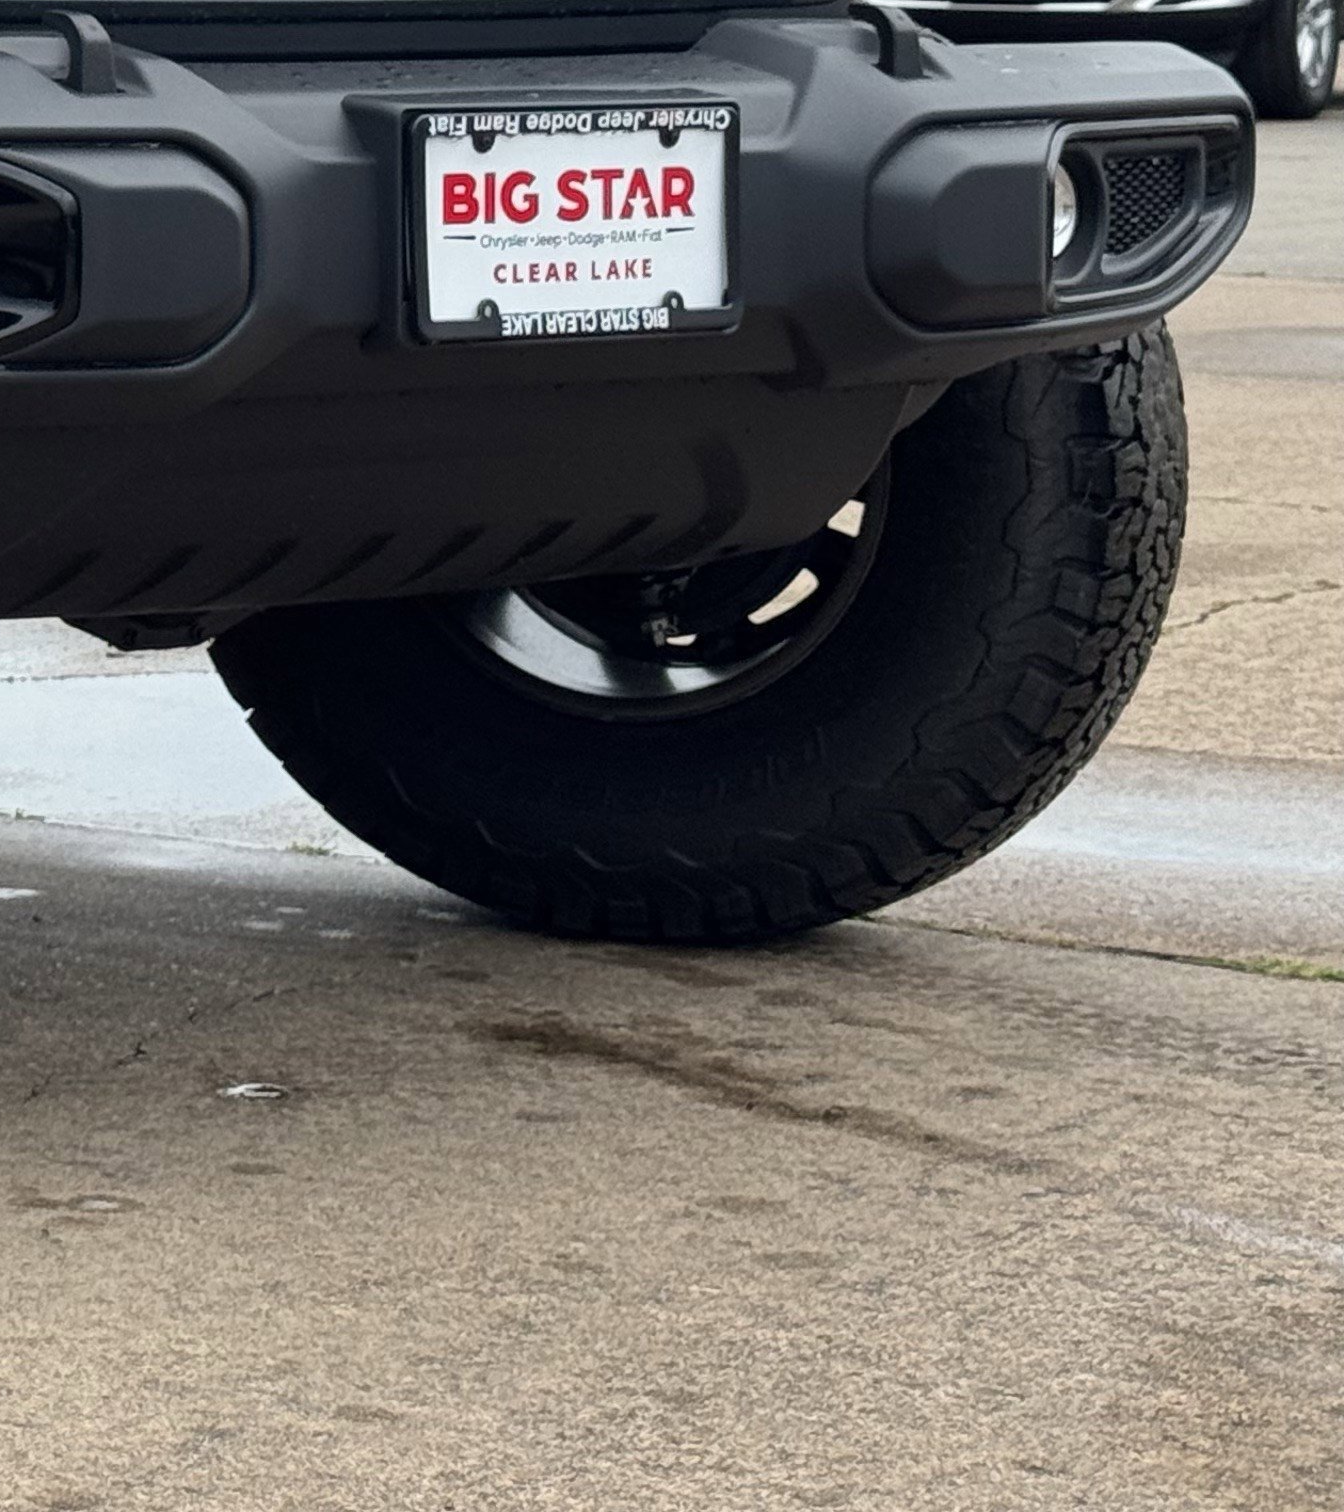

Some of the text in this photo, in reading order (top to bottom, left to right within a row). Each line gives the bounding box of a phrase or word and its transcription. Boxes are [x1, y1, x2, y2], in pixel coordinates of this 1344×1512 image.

[428, 107, 730, 136] Chrysler Jeep Dodge Ram Fiat
[443, 166, 695, 225] BIG STAR
[493, 257, 653, 284] CLEAR LAKE
[501, 307, 669, 337] BIG STAR CLEAR LAKE
